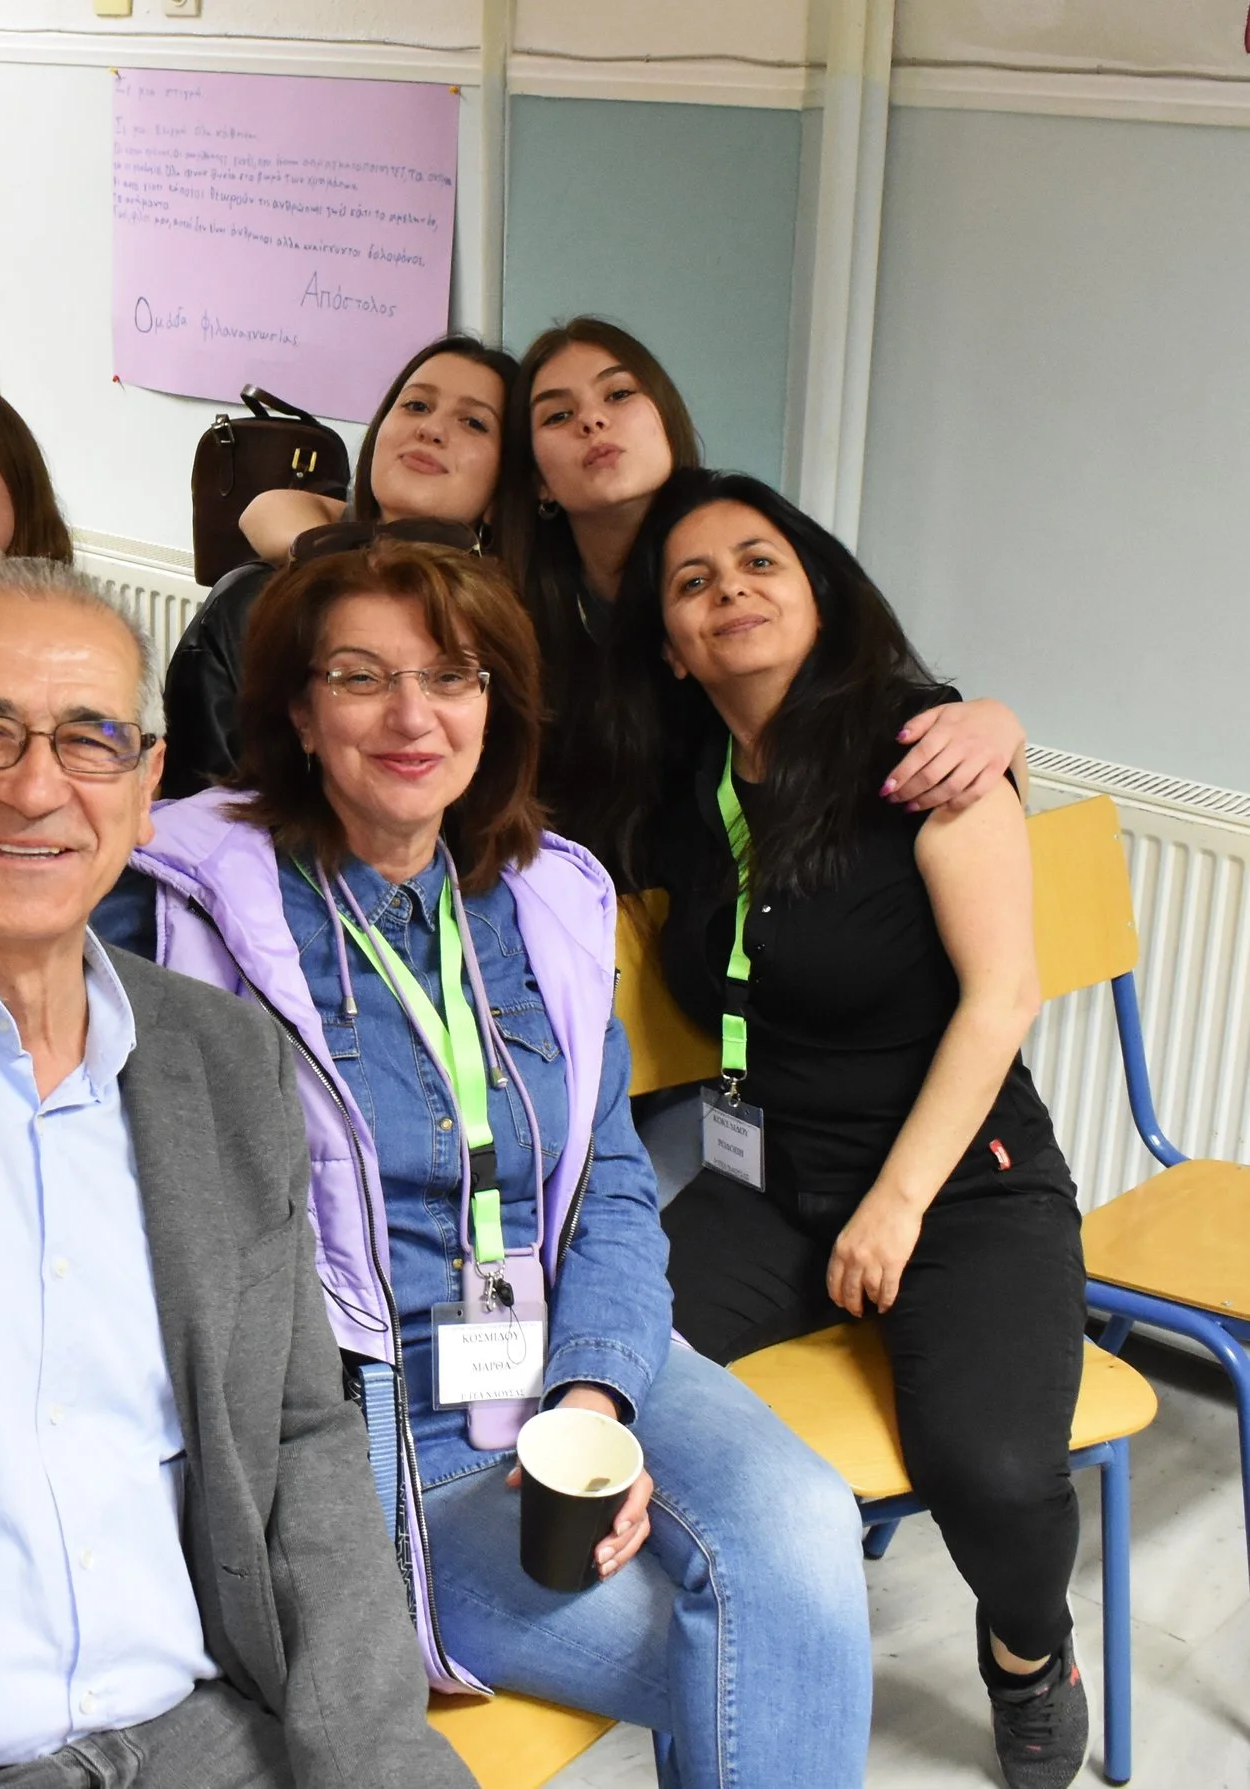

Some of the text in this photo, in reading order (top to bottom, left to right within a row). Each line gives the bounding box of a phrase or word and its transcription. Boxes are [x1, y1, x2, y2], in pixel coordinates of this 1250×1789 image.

[300, 269, 398, 318] Απόστολος
[133, 296, 188, 334] Ομάδα
[462, 1330, 519, 1344] ΚΟΣΜΙΔΟΥ
[472, 1360, 512, 1373] ΜΑΡΘΑ
